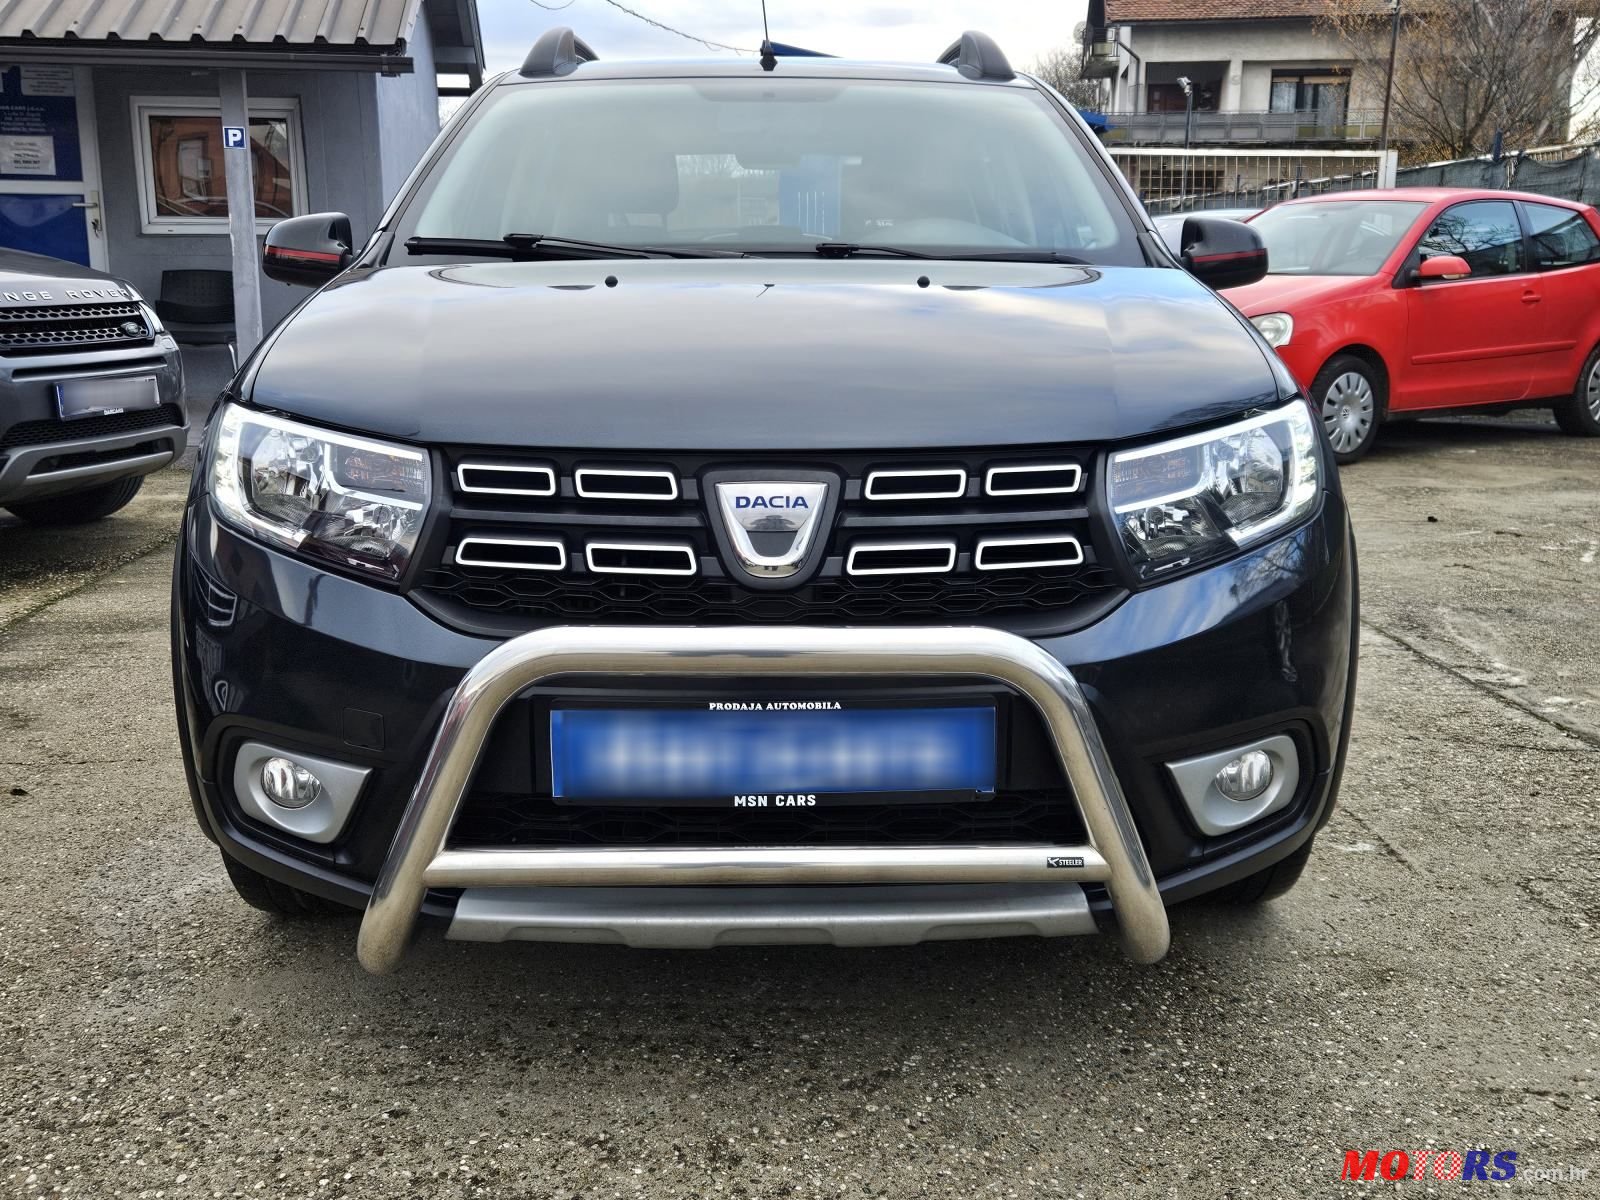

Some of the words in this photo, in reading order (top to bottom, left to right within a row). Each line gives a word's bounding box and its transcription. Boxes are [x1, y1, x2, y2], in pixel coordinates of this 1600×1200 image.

[228, 129, 242, 147] P
[2, 291, 53, 301] NGE
[65, 288, 130, 299] ROVER
[735, 495, 809, 509] DACIA
[709, 702, 763, 711] PRODAJA
[766, 701, 842, 711] AUTOMOBILA
[734, 795, 768, 807] MSN
[775, 794, 816, 807] CARS
